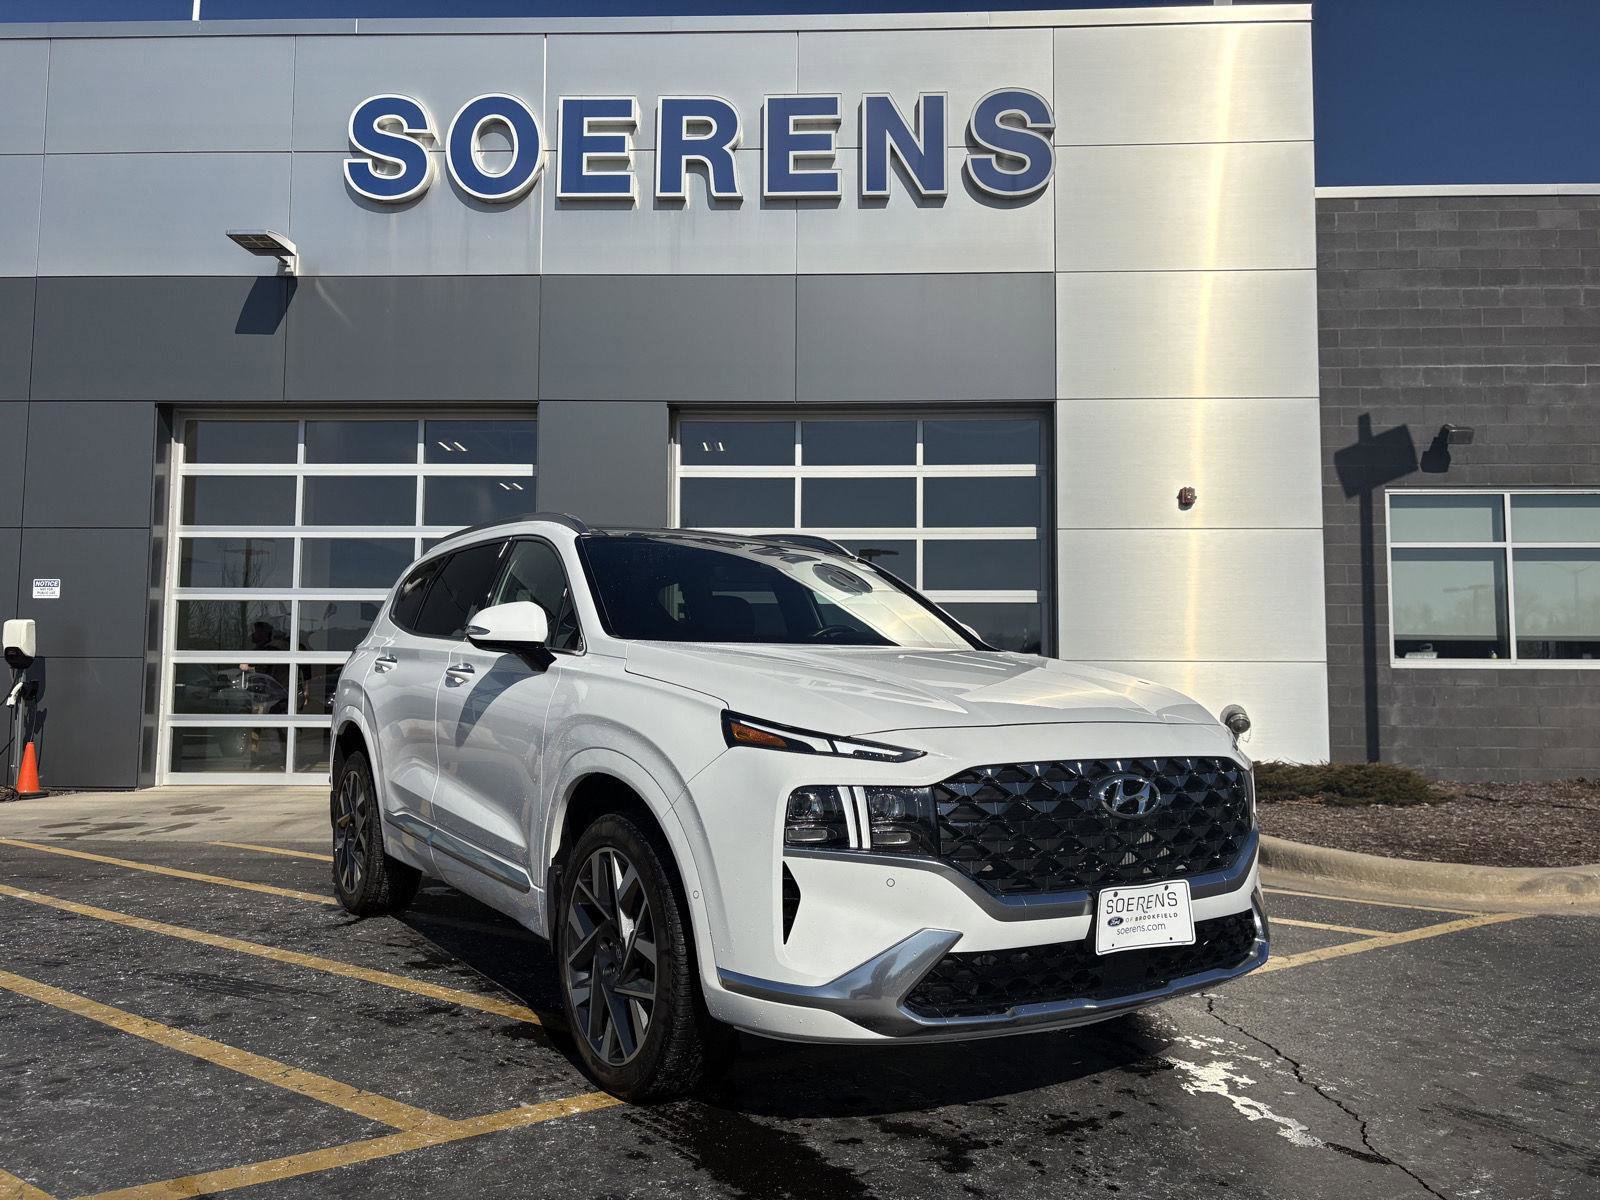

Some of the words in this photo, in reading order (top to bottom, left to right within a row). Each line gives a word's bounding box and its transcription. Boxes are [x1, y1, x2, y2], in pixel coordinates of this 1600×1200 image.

[344, 87, 1056, 200] SOERENS
[1106, 892, 1178, 914] SOERENS
[1135, 912, 1178, 921] BROOKFIELD
[1116, 923, 1166, 935] soerens.com
